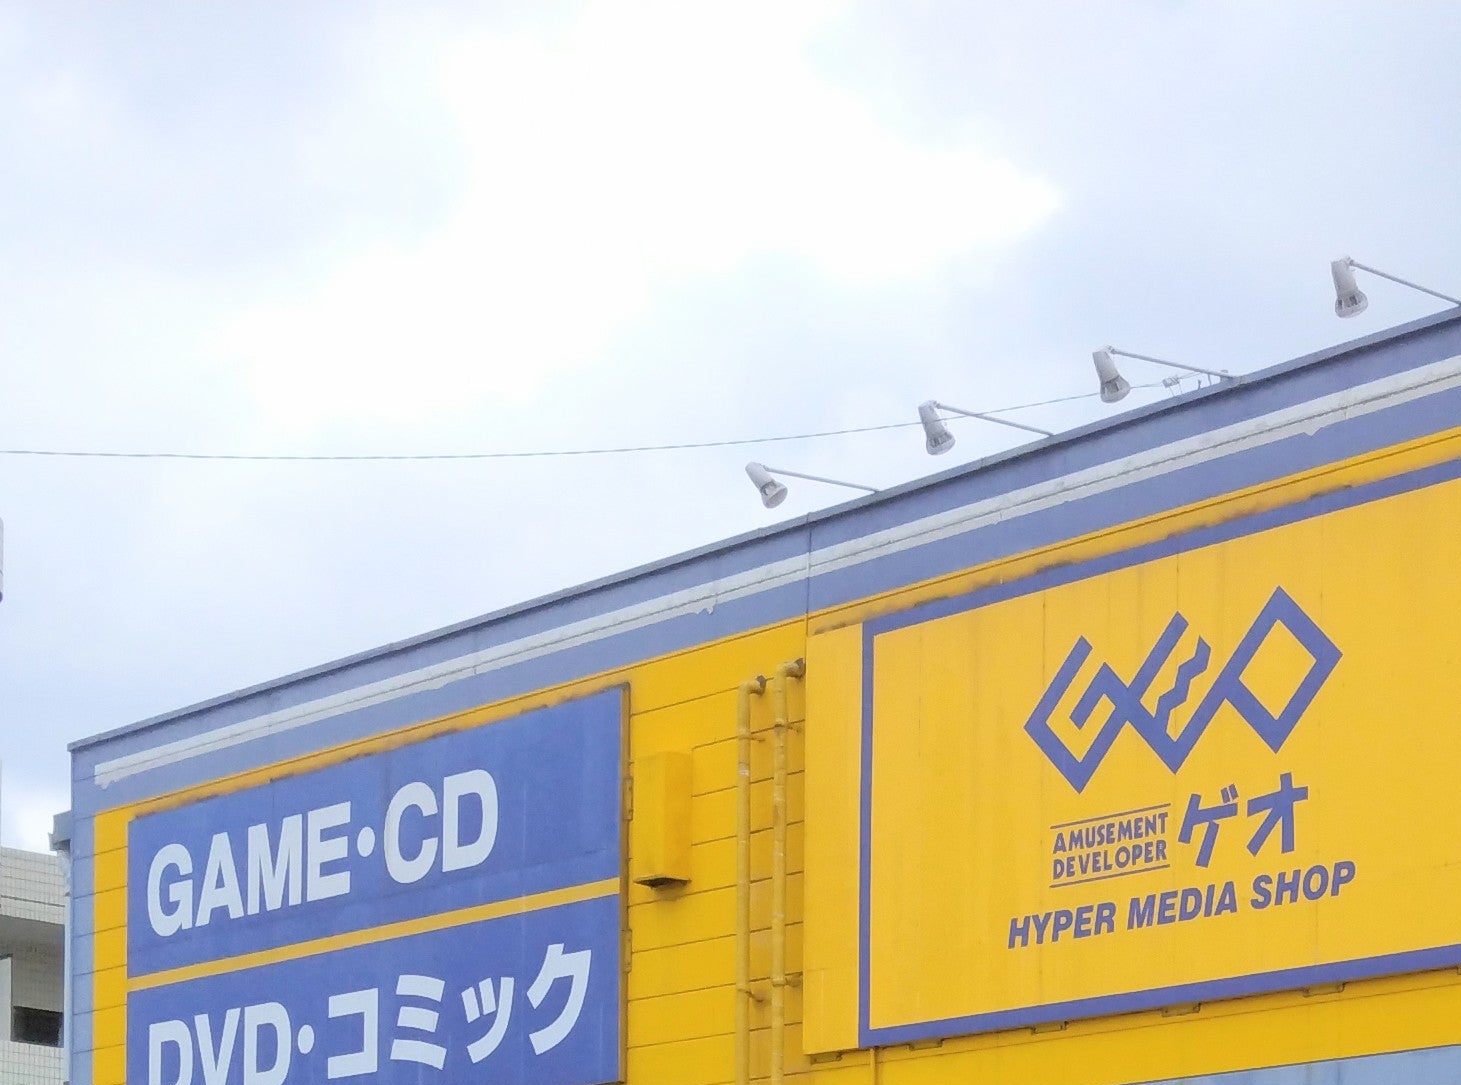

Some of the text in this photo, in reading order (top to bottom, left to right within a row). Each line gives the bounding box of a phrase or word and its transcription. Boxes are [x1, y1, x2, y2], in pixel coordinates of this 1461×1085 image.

[1053, 811, 1169, 854] AMUSEMENT
[1178, 772, 1309, 868] ゲオ
[1053, 840, 1167, 880] DEVELOPER
[1007, 860, 1356, 949] HYPER MEDIA SHOP
